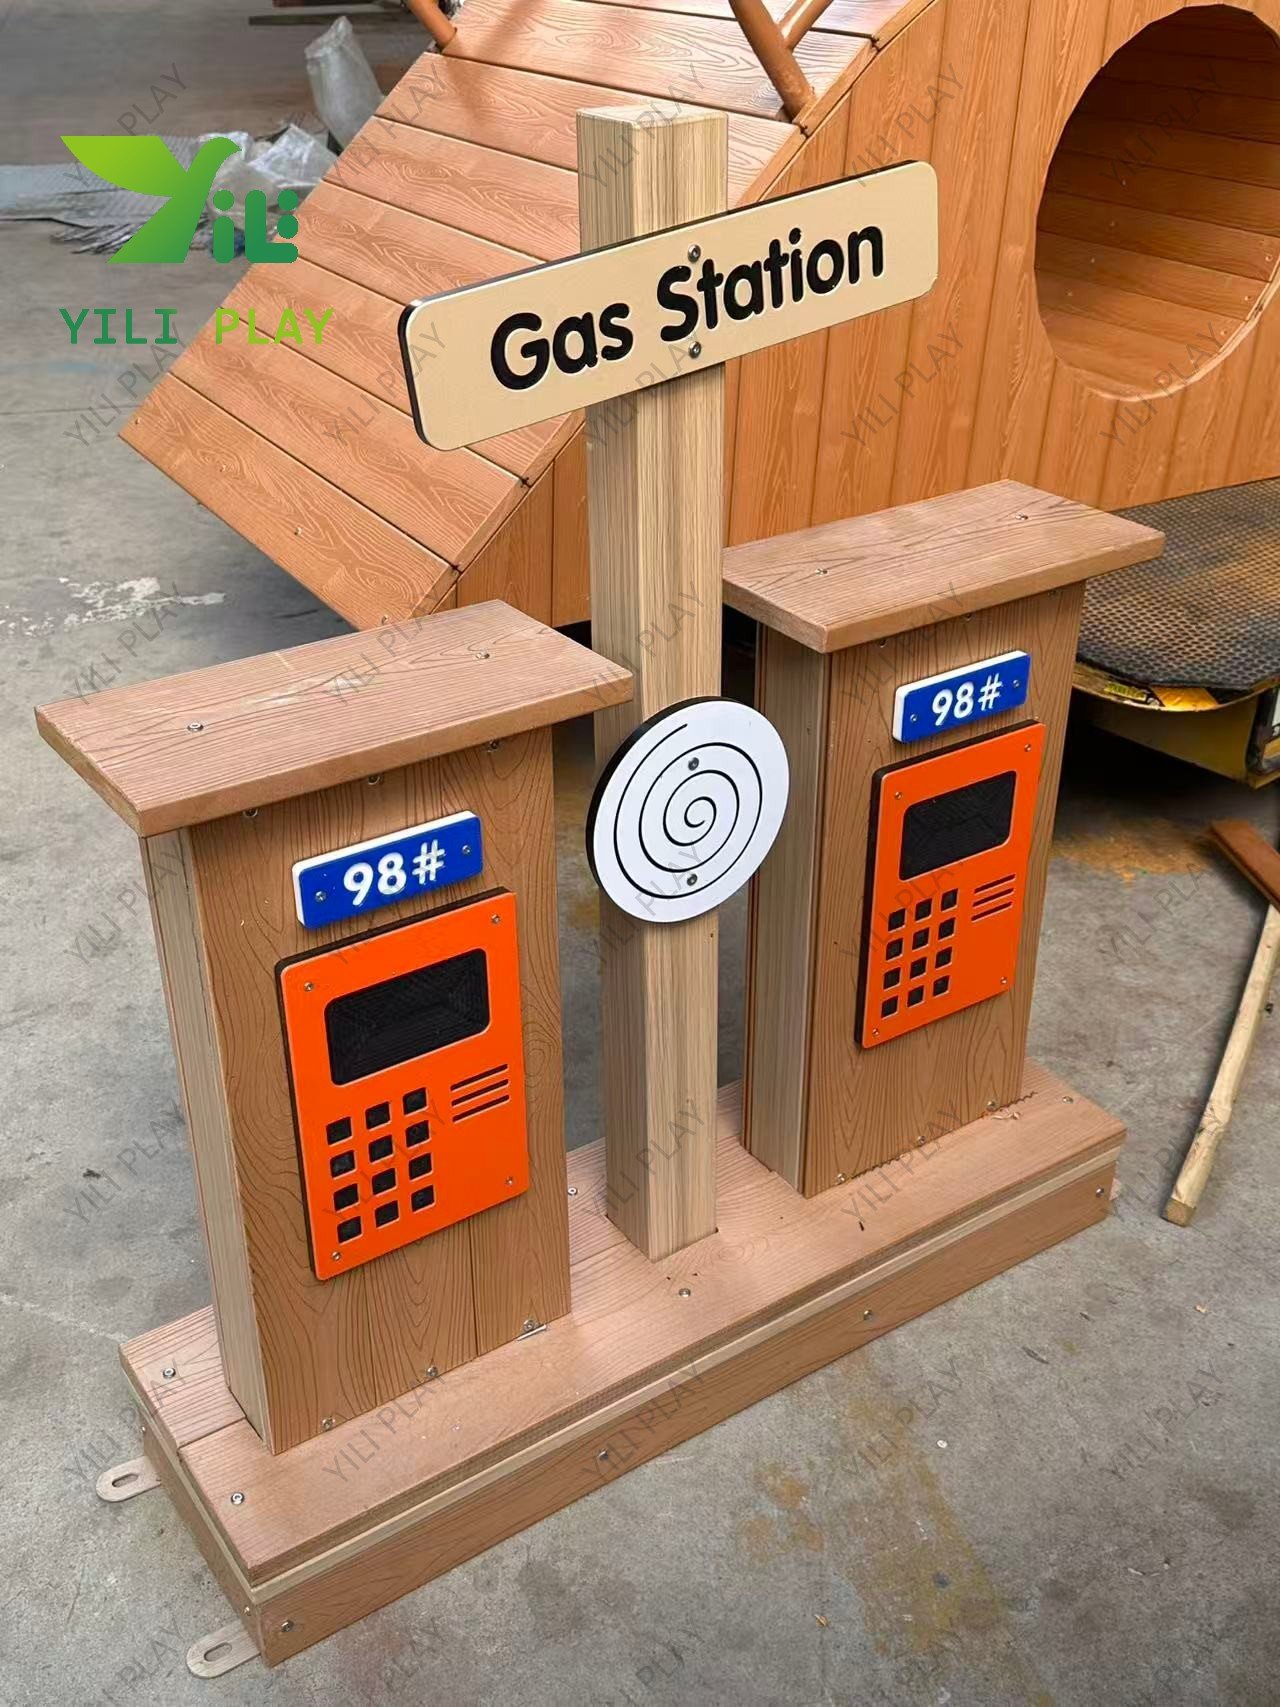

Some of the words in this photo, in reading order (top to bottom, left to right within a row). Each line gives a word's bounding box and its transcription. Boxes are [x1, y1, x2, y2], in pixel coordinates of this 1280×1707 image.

[490, 301, 635, 391] Gas
[656, 225, 885, 343] Station
[931, 673, 1004, 727] 98#
[343, 839, 446, 907] 98#
